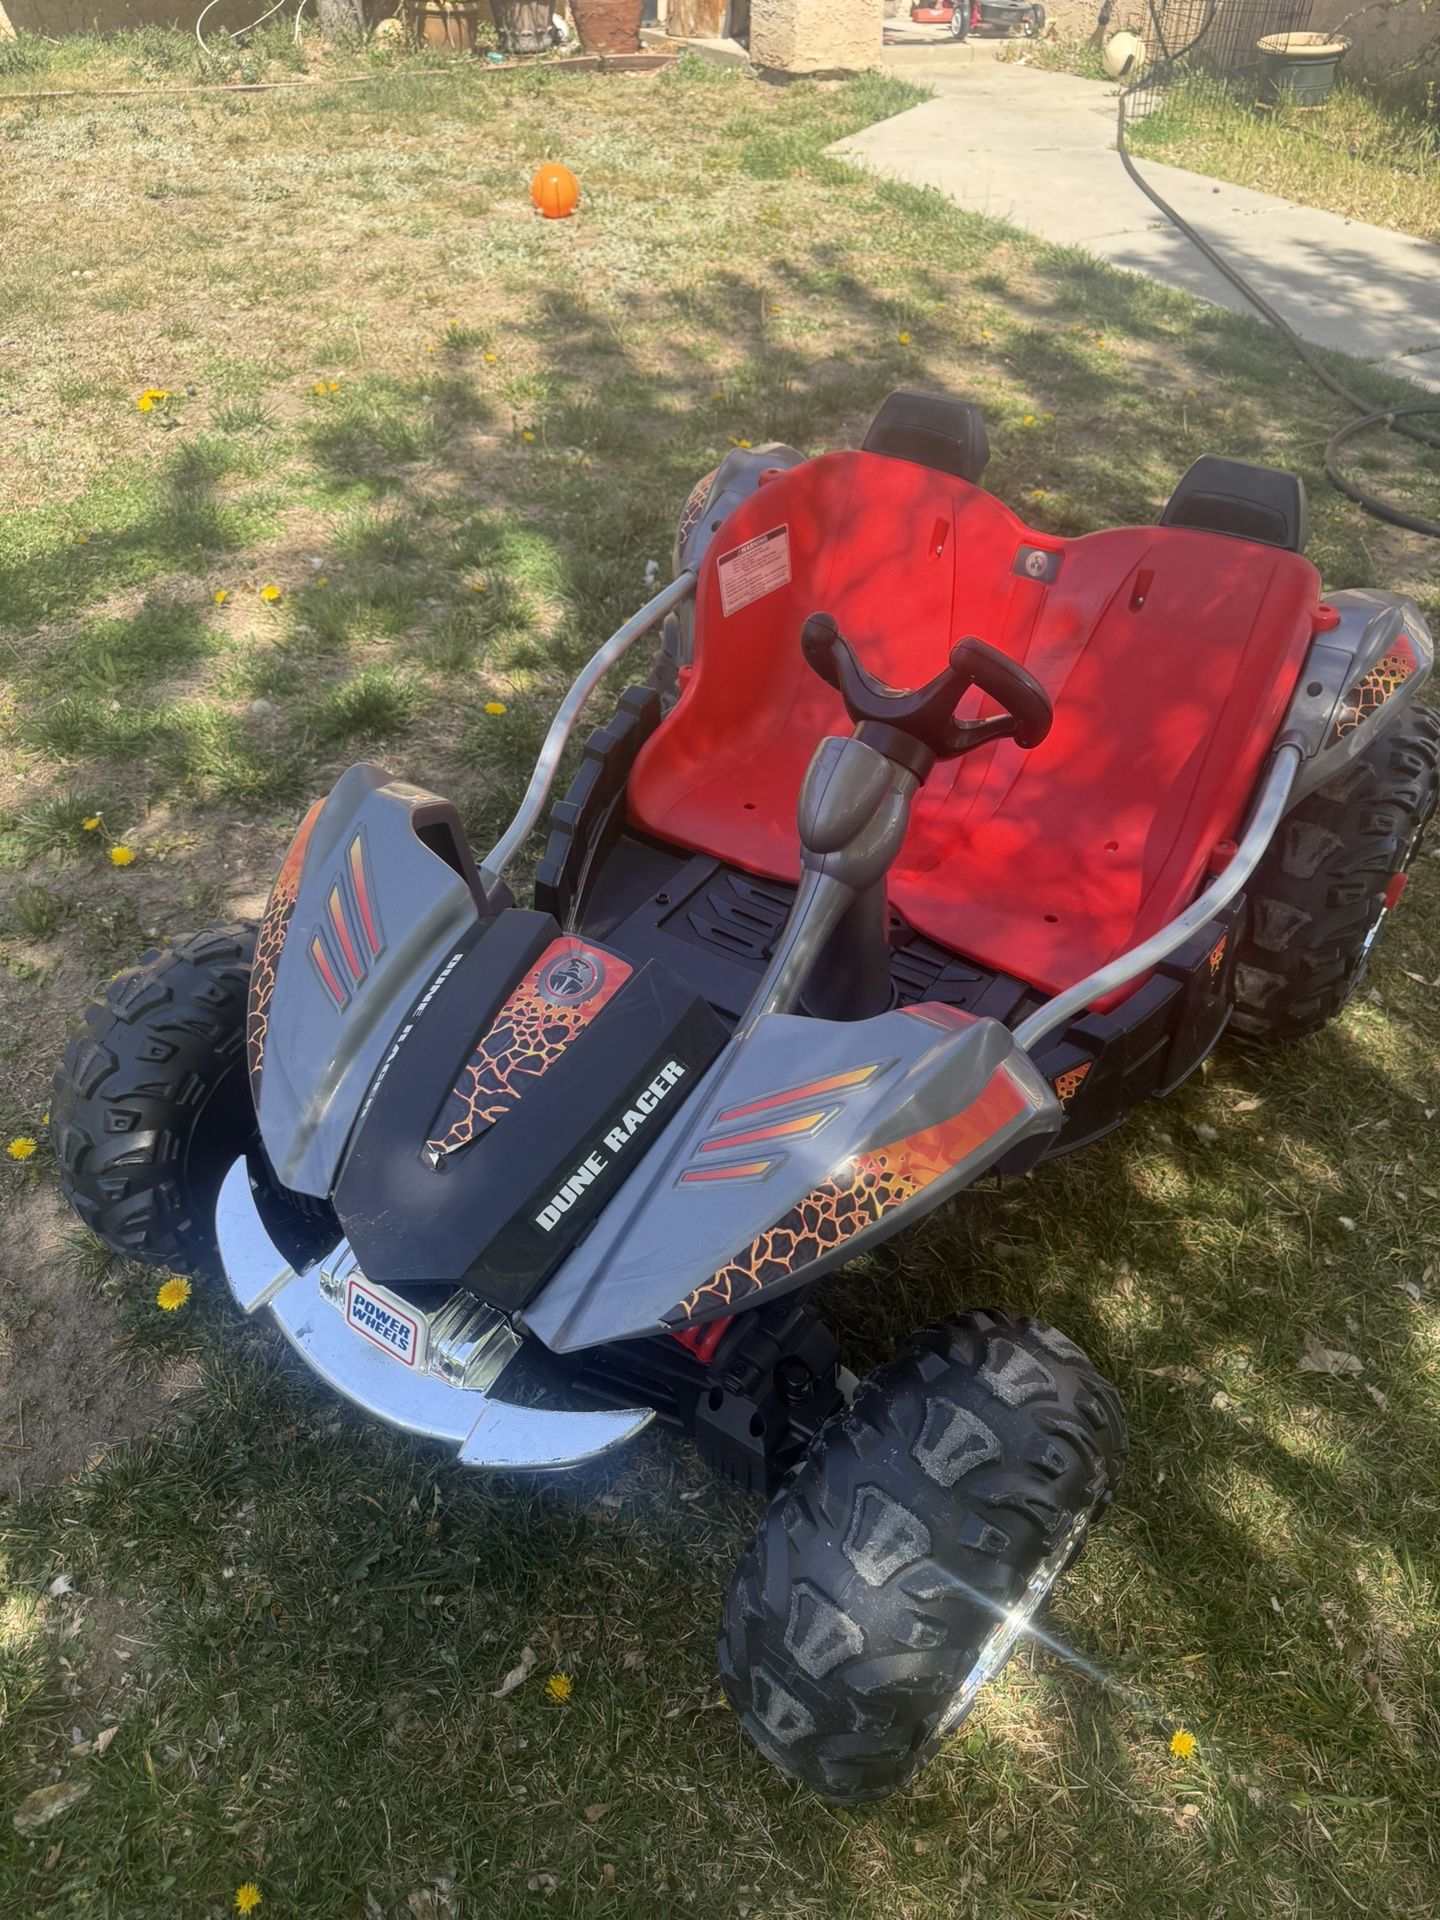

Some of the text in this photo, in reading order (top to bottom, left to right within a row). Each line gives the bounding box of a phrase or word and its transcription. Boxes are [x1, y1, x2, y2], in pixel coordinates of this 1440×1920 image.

[412, 953, 464, 1019] DUNE
[535, 1060, 686, 1232] DUNE RACER
[352, 1305, 409, 1352] WHEELS
[354, 1293, 411, 1339] POWER
